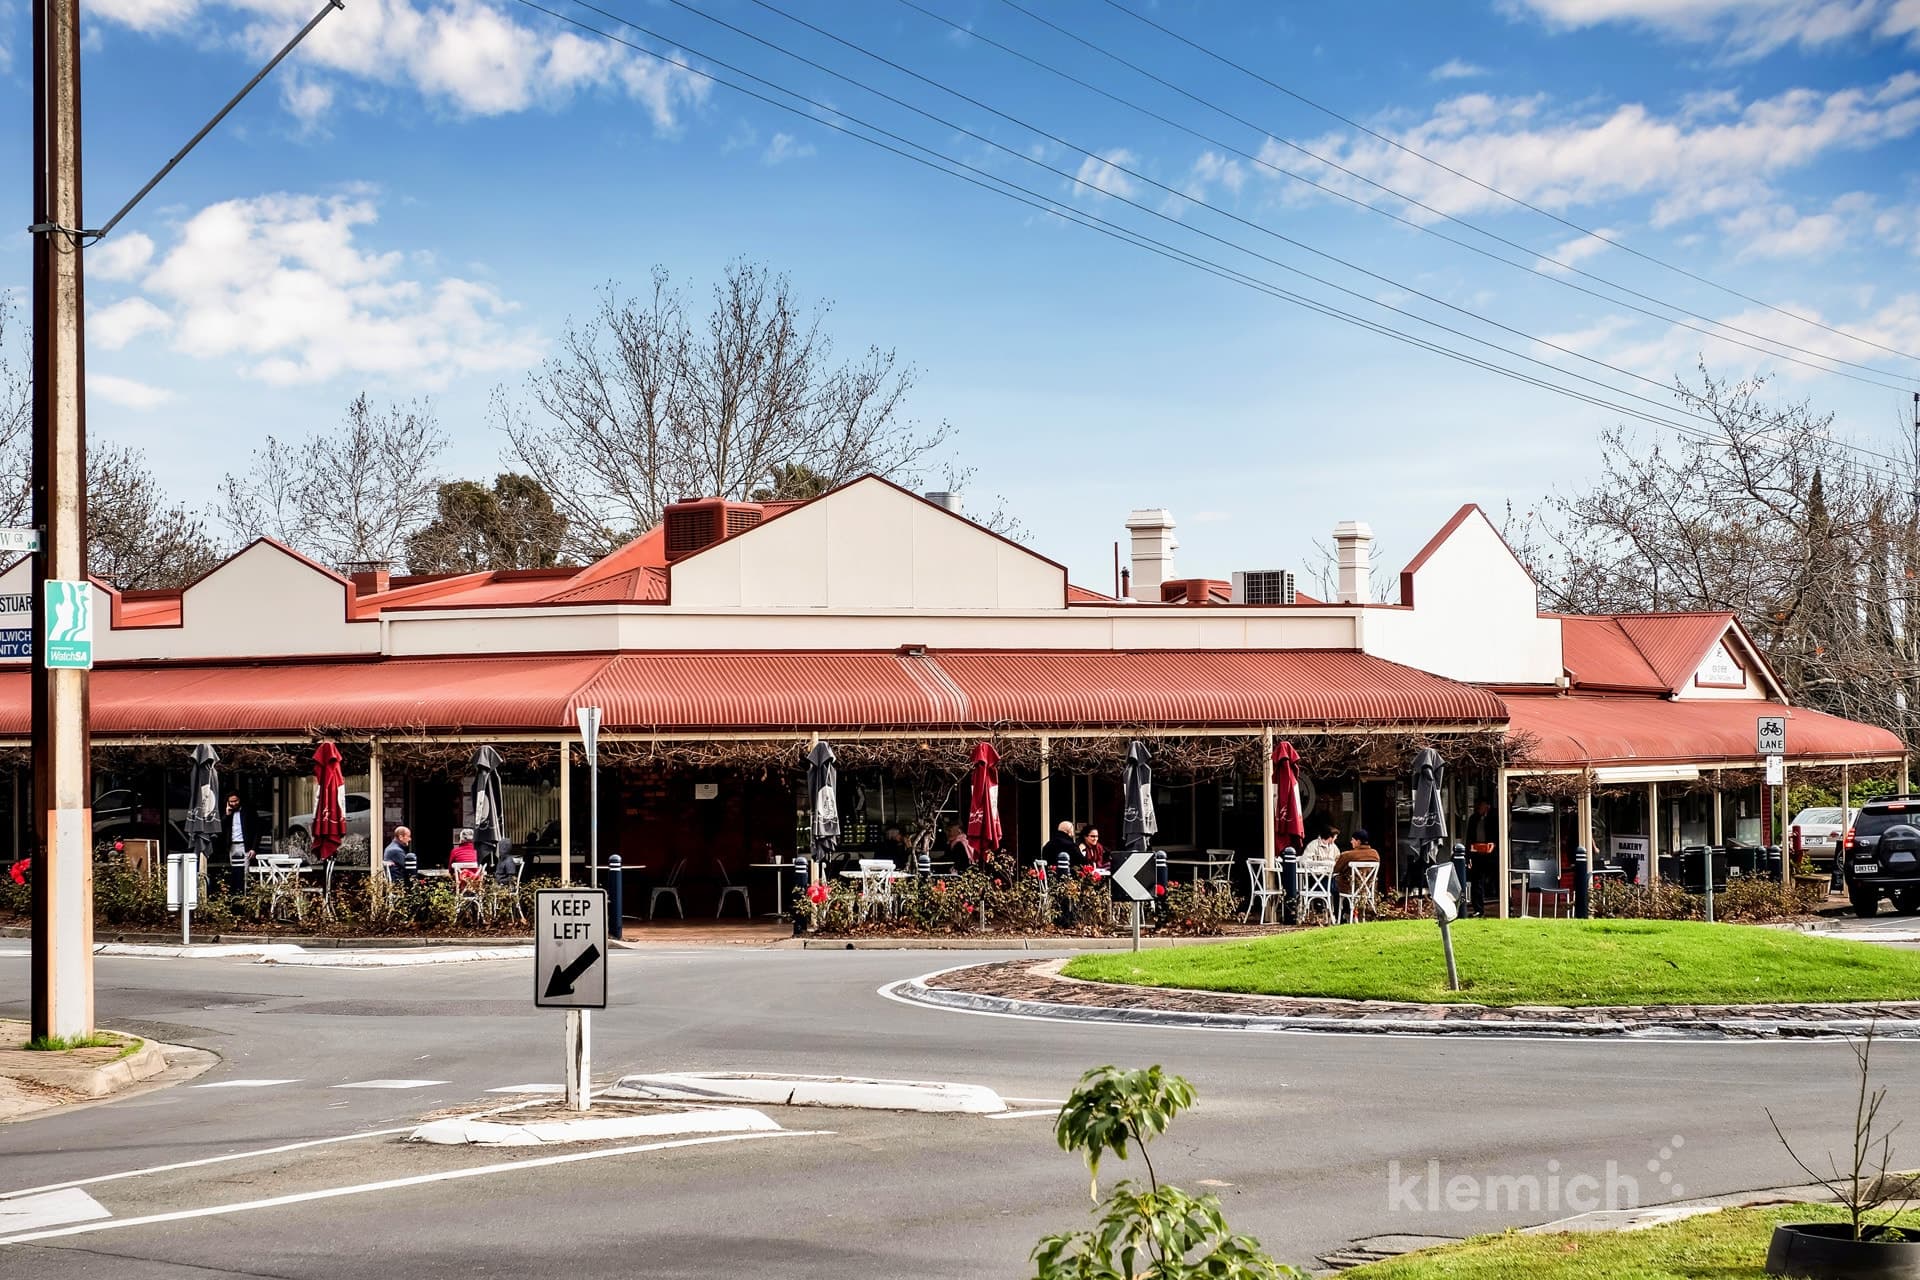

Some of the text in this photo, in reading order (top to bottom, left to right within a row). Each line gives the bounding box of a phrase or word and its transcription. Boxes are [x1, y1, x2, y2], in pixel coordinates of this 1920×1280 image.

[0, 631, 31, 641] LWICH
[51, 651, 87, 661] WatchSA
[1760, 740, 1783, 749] LANE
[1618, 842, 1642, 851] BAKERY
[551, 900, 591, 916] KEEP
[553, 923, 591, 939] LEFT
